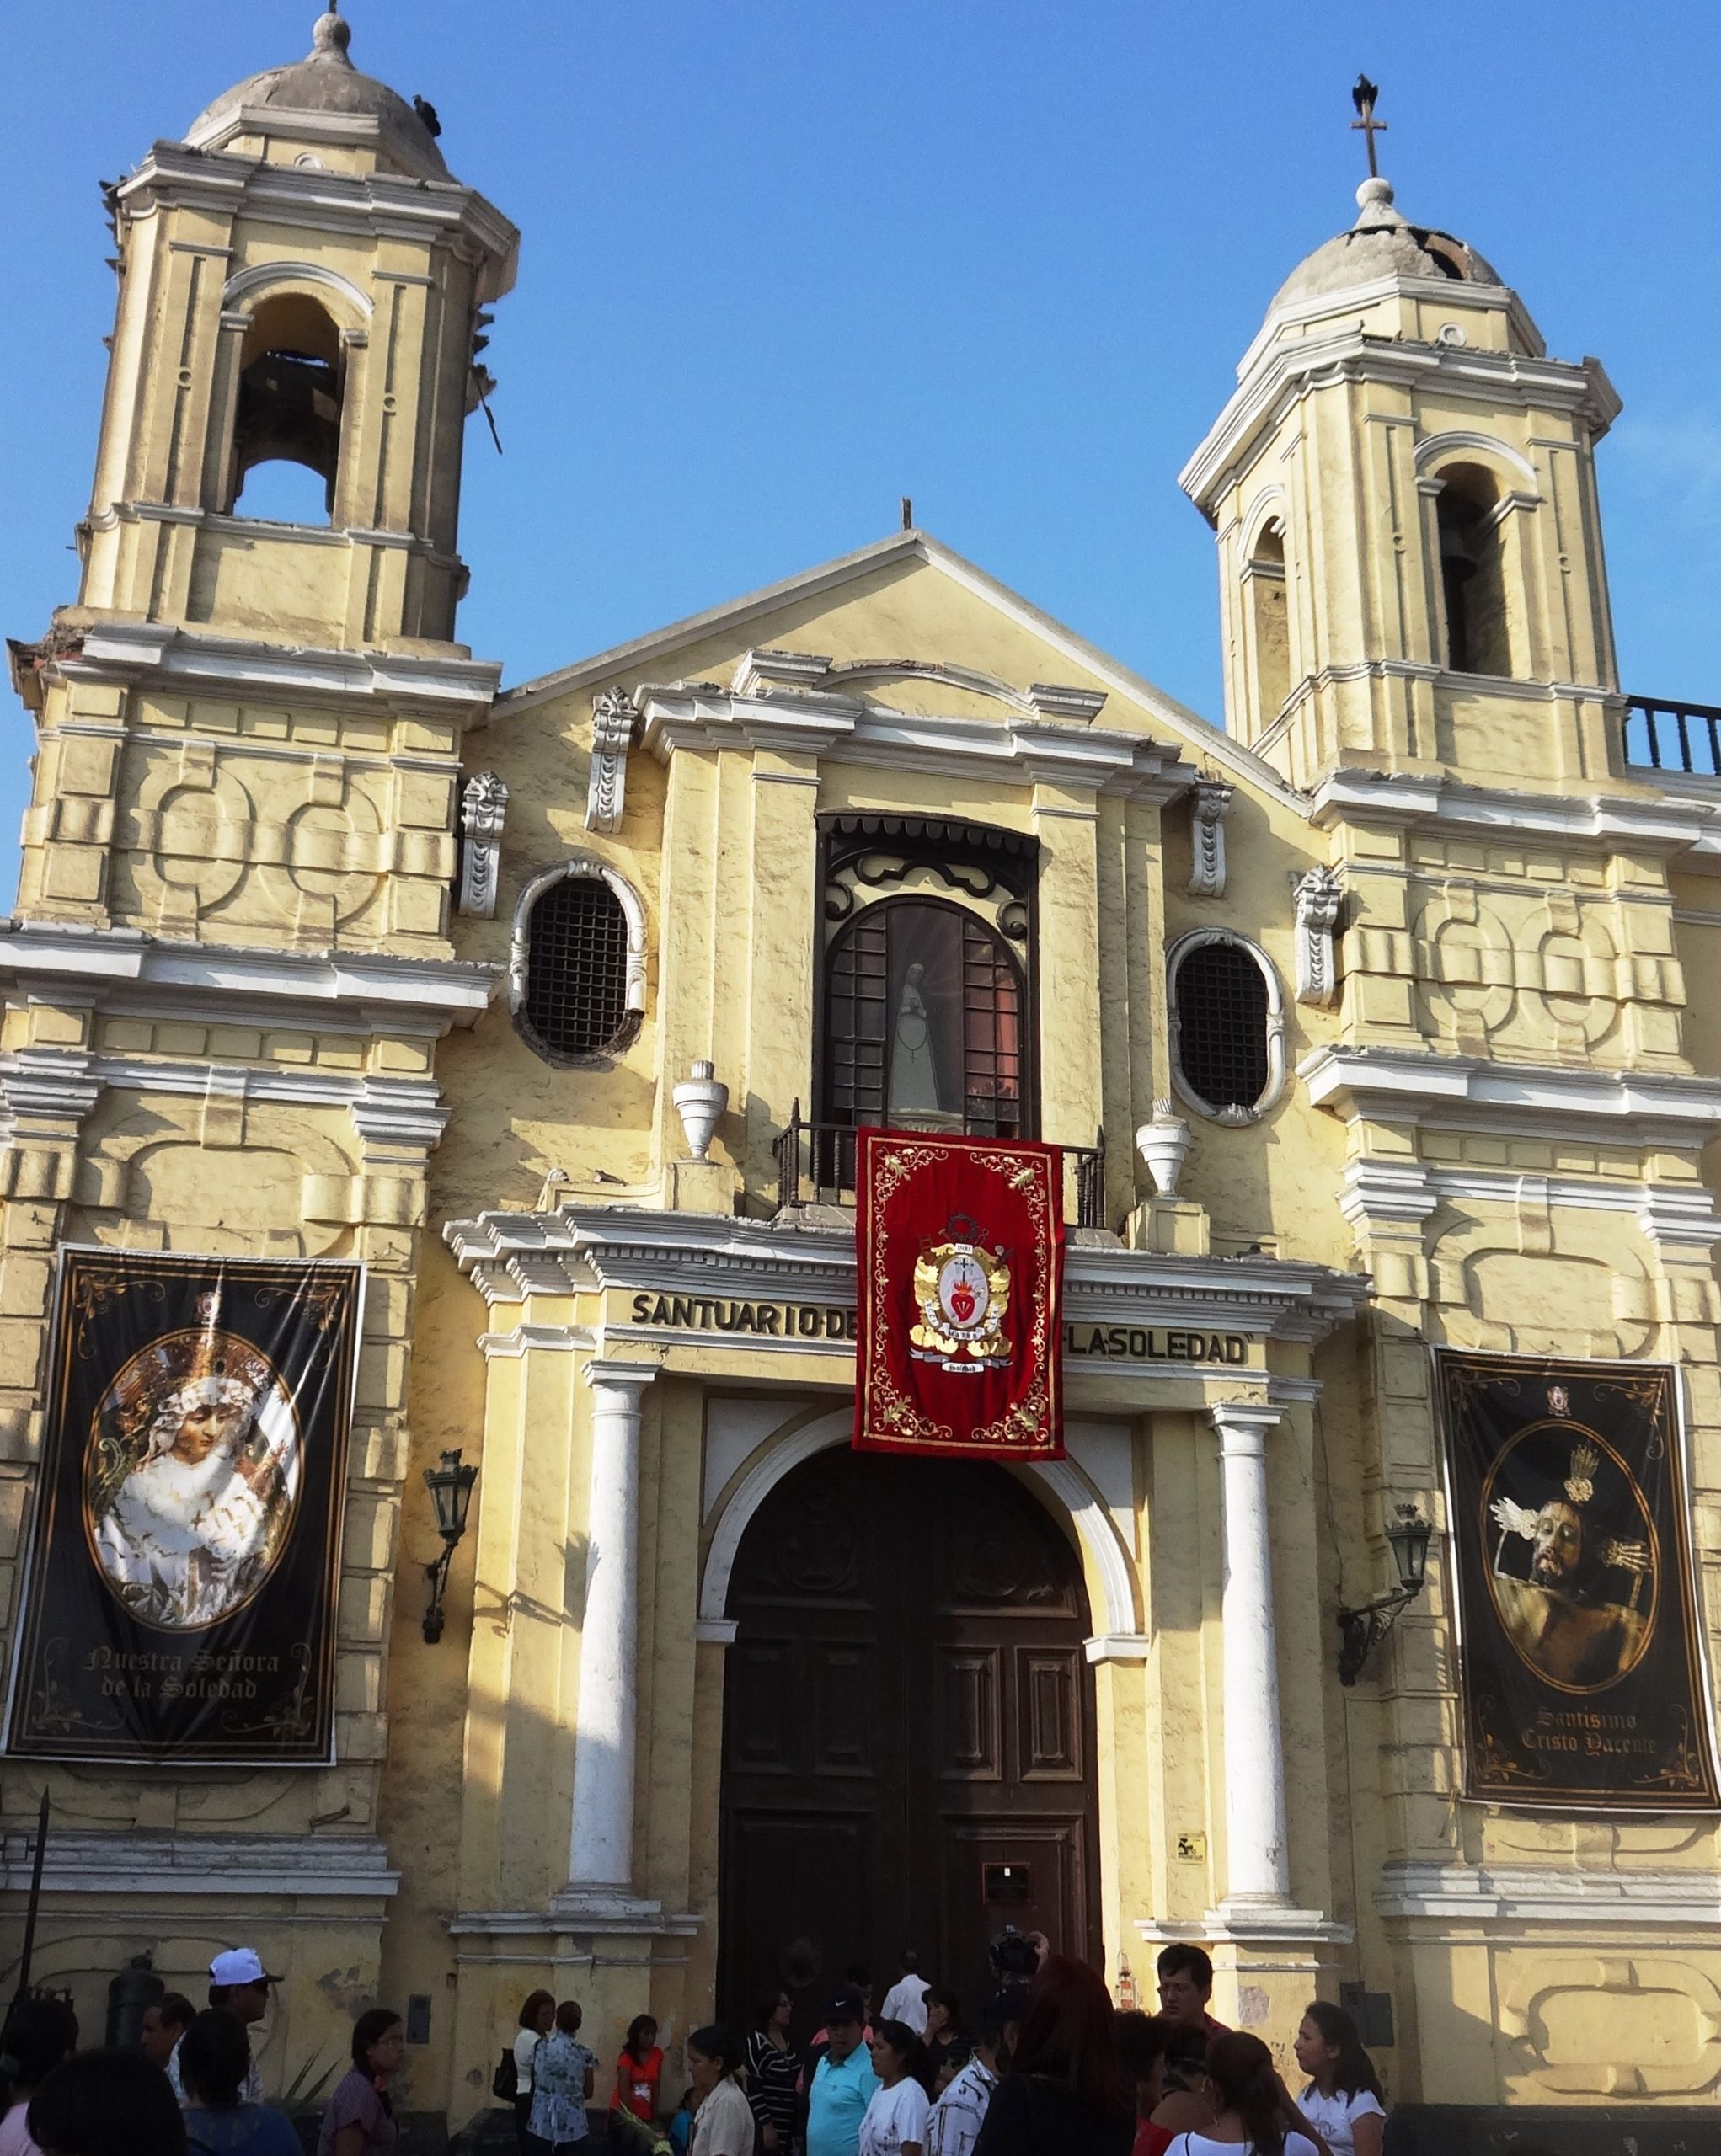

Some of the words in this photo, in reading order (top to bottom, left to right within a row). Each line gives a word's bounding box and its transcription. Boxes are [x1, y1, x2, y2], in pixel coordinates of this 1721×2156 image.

[631, 1294, 819, 1337] SANTUARIO
[82, 1645, 182, 1673] Nuestra
[190, 1648, 280, 1673] Señora
[100, 1674, 127, 1698] de
[133, 1674, 152, 1699] la
[159, 1674, 258, 1700] Soledad
[1521, 1727, 1578, 1752] Cristo
